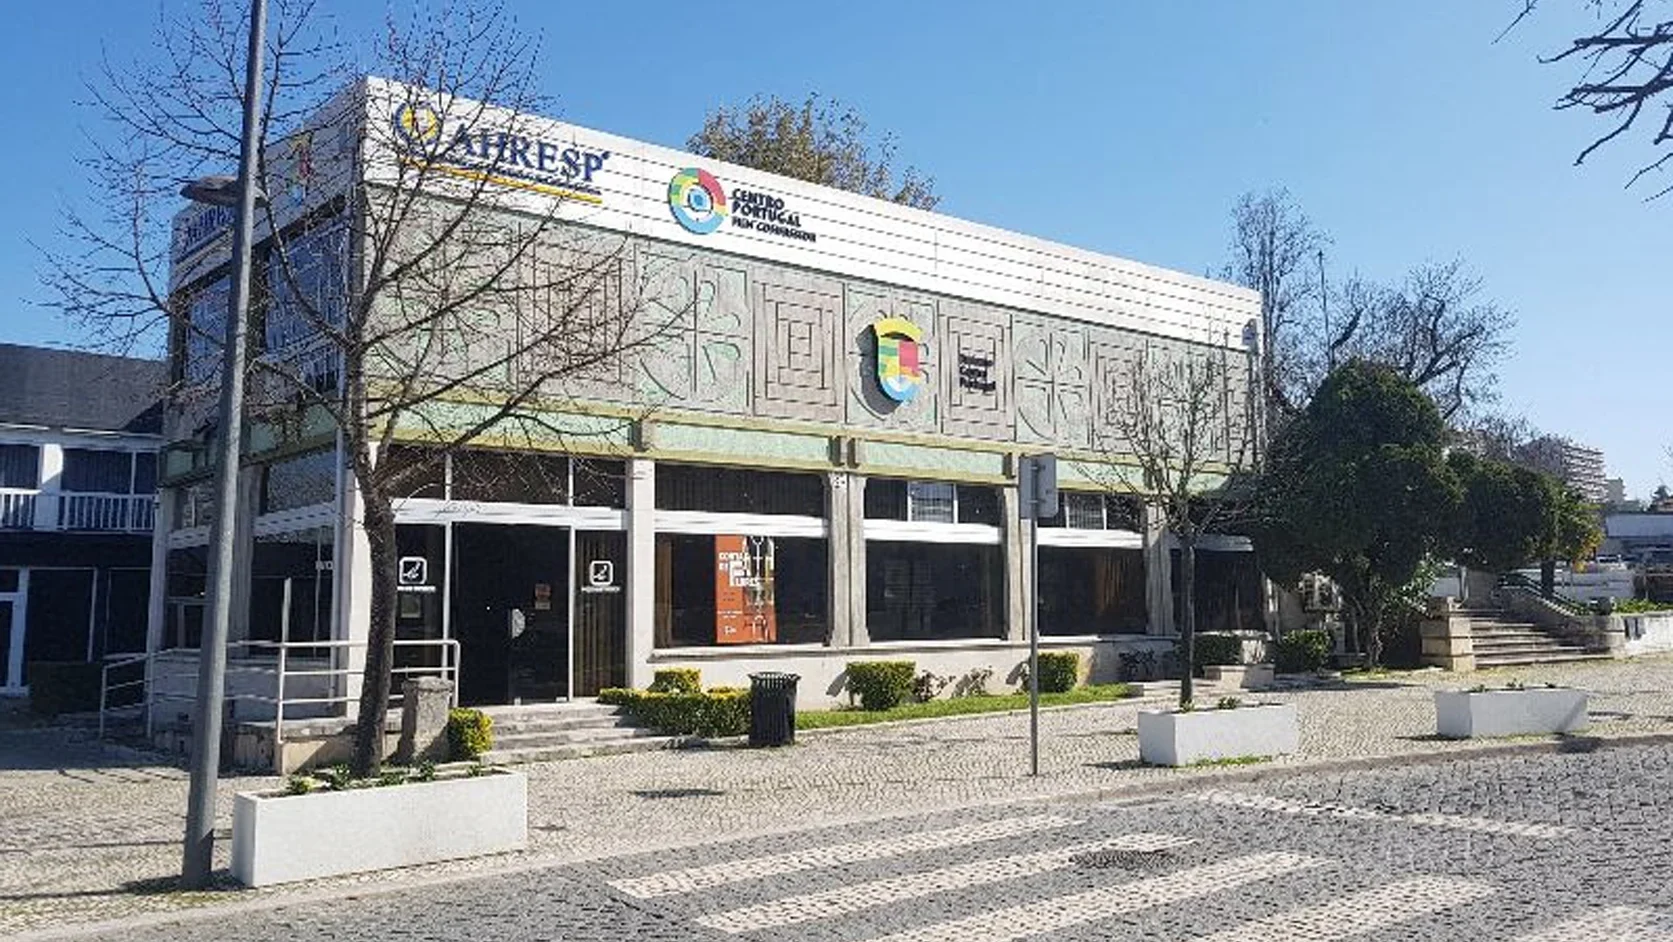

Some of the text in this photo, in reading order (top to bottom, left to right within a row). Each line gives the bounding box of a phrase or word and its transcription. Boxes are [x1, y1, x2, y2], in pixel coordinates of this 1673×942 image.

[455, 123, 605, 183] AHRESP
[731, 187, 786, 211] CENTRO
[731, 200, 802, 228] PORTUGAL
